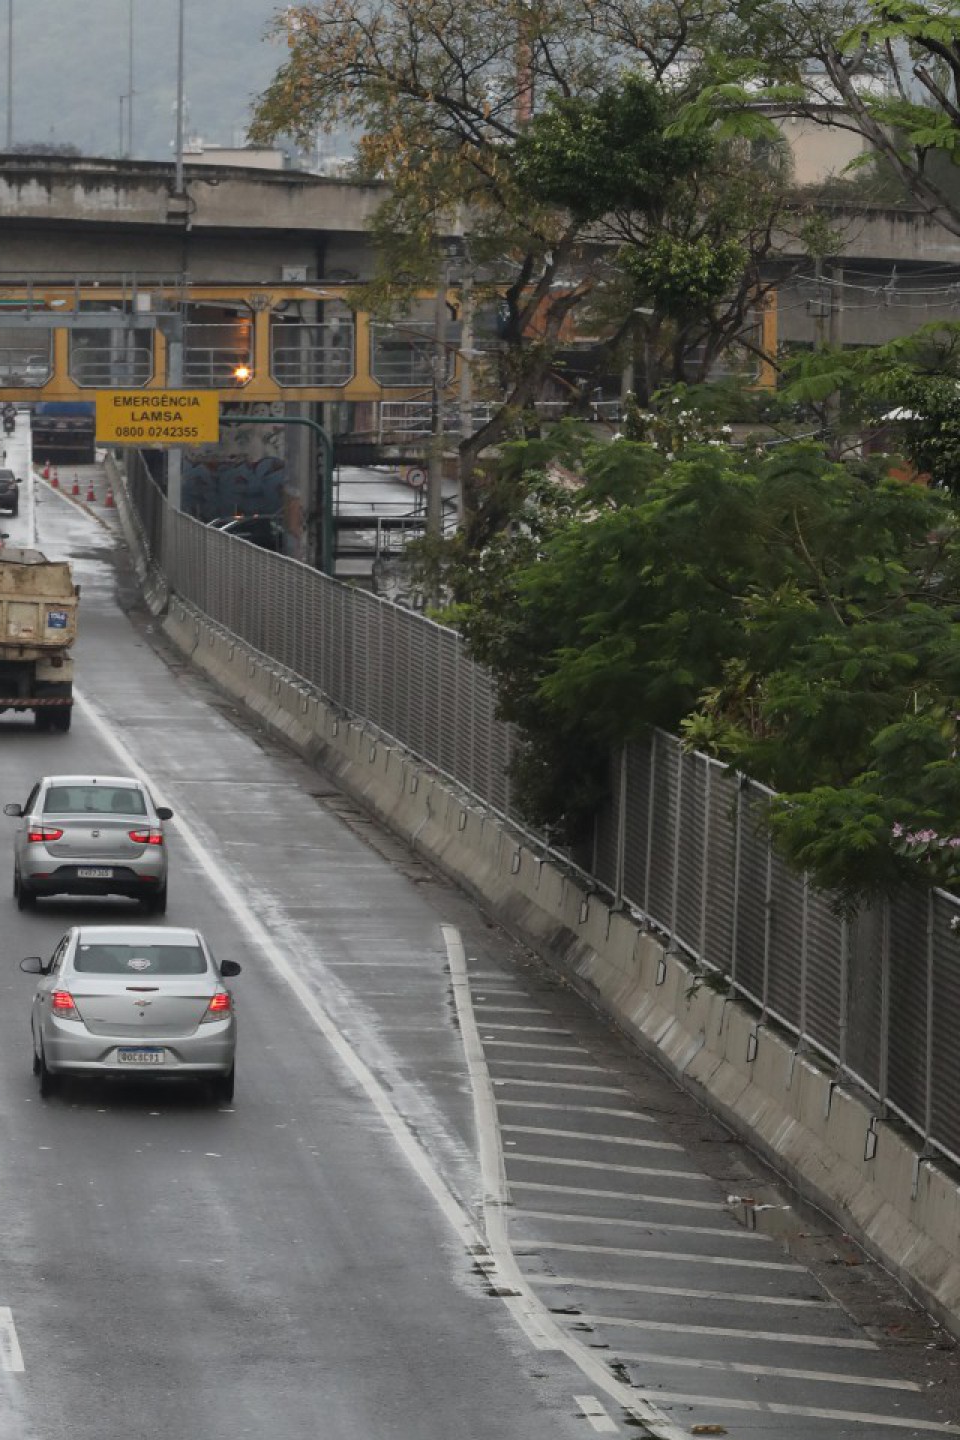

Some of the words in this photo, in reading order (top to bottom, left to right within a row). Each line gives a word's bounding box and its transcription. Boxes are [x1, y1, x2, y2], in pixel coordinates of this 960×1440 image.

[113, 394, 200, 407] EMERGÊNCIA
[131, 411, 183, 422] LAMSA
[115, 426, 144, 437] 0800
